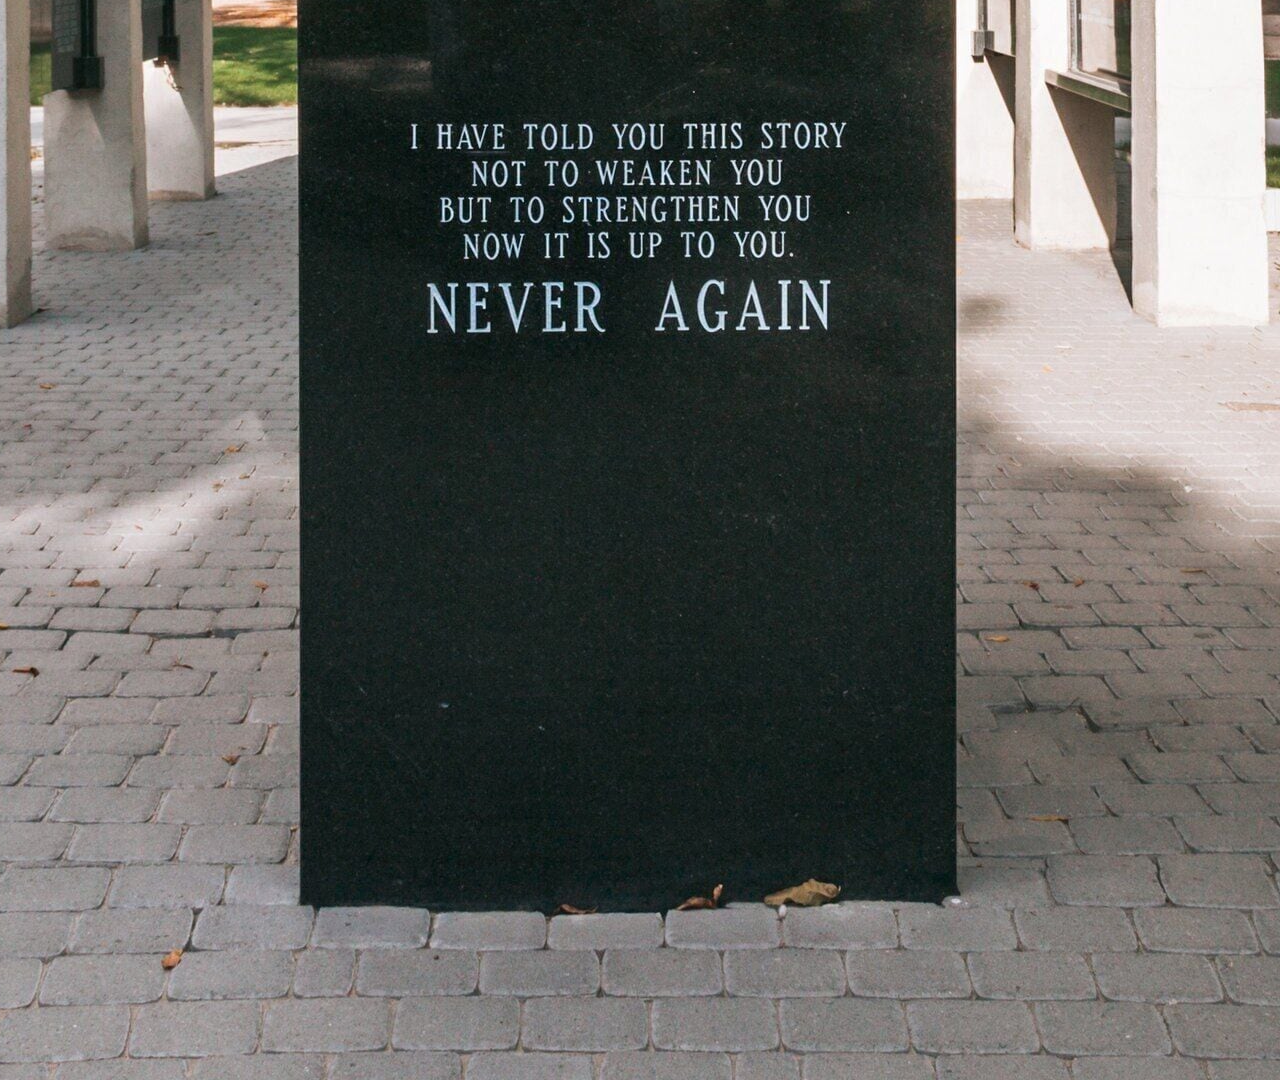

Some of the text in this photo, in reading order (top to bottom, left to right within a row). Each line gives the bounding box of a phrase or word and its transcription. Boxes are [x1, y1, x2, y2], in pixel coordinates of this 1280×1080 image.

[412, 122, 847, 150] I HAVE TOLD YOU THIS STORY
[472, 159, 783, 187] NOT TO WEAKEN YOU
[440, 195, 811, 223] BUT TO STRENGTHEN YOU
[464, 231, 794, 260] NOW IT IS UP TO YOU.
[427, 280, 831, 333] NEVER AGAIN
